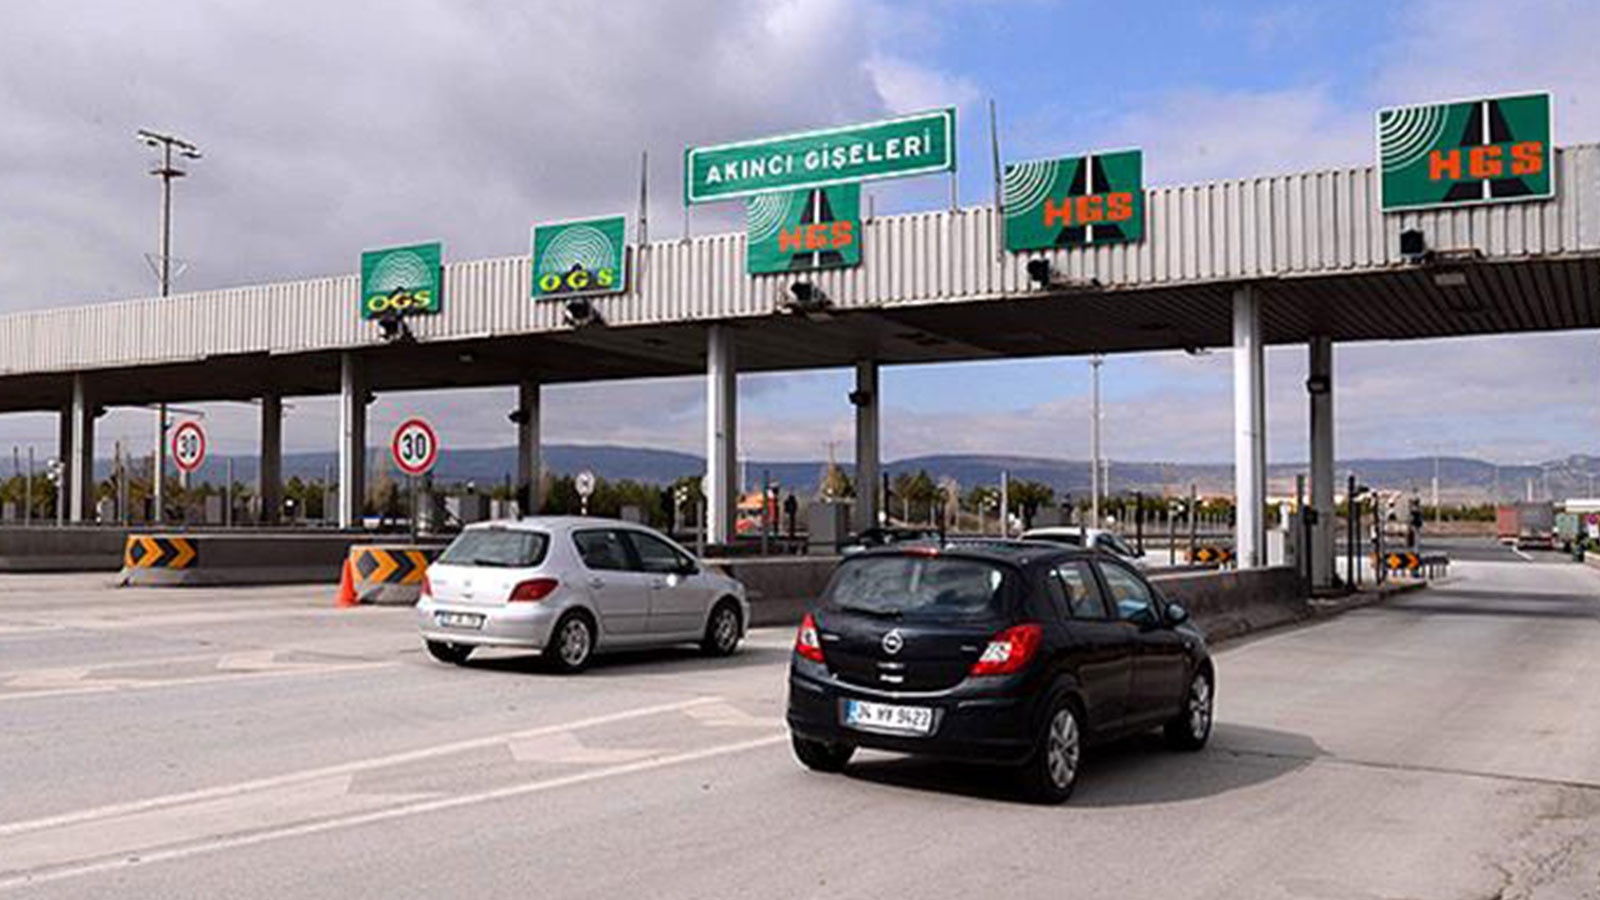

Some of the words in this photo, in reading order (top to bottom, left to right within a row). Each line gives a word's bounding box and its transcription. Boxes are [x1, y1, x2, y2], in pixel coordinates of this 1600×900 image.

[705, 155, 793, 185] AKINCI
[804, 128, 930, 170] GİŞELERİ
[1429, 141, 1543, 180] HGS
[1044, 192, 1133, 227] HGS
[778, 220, 853, 253] HGS
[539, 268, 613, 292] OGS
[367, 290, 431, 311] OGS
[180, 434, 198, 458] 30
[402, 433, 427, 461] 30
